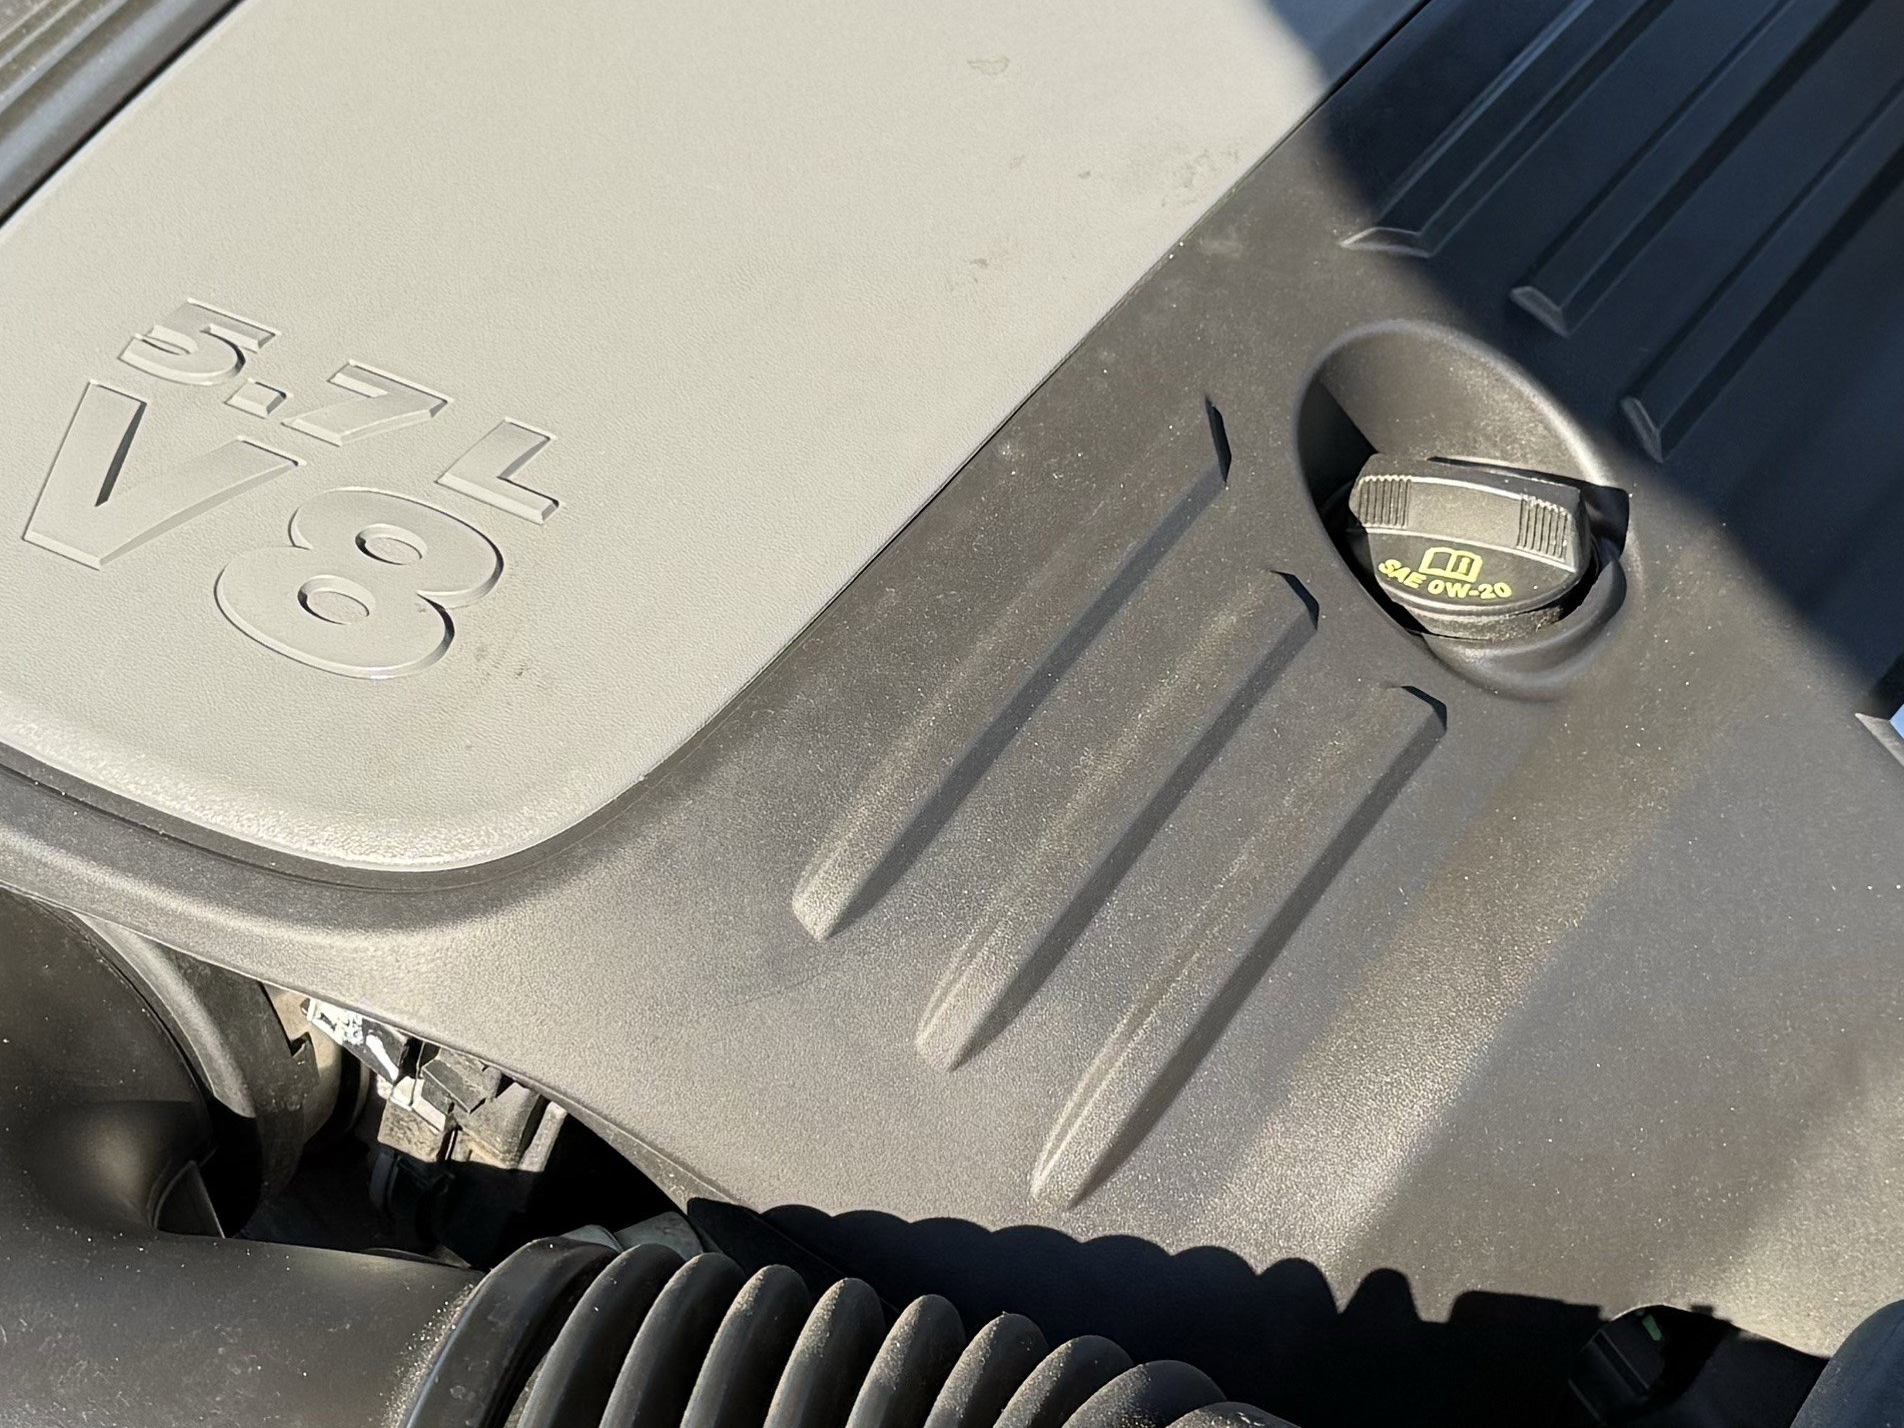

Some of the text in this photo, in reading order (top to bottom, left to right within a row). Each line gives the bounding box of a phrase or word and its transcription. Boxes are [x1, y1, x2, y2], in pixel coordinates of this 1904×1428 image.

[21, 379, 505, 680] V8
[1378, 559, 1513, 600] SAE 0W-20
